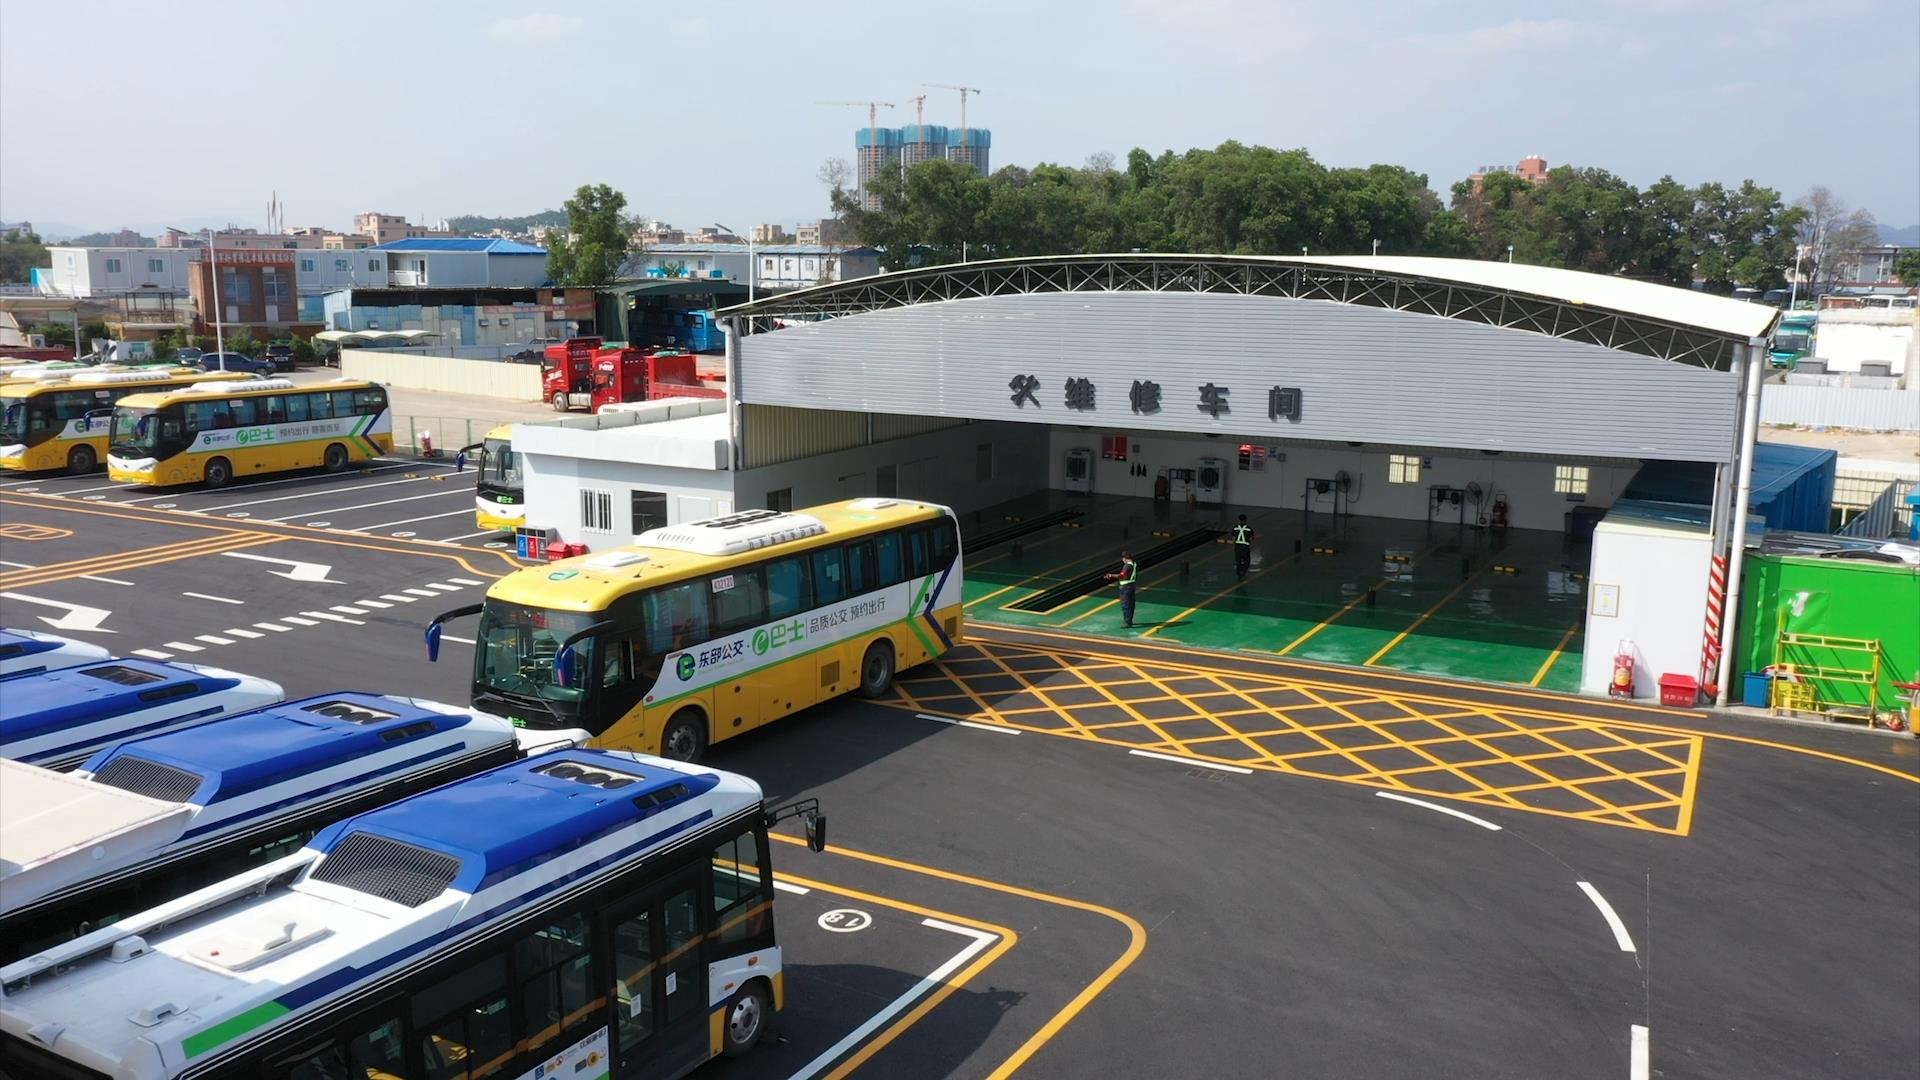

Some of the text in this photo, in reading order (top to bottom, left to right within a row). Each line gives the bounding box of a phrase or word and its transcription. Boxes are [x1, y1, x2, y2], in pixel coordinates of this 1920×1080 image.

[1064, 376, 1303, 422] 维修车间
[698, 639, 744, 668] 东部公交
[809, 609, 848, 633] 品质公交
[850, 597, 886, 621] 预约出行
